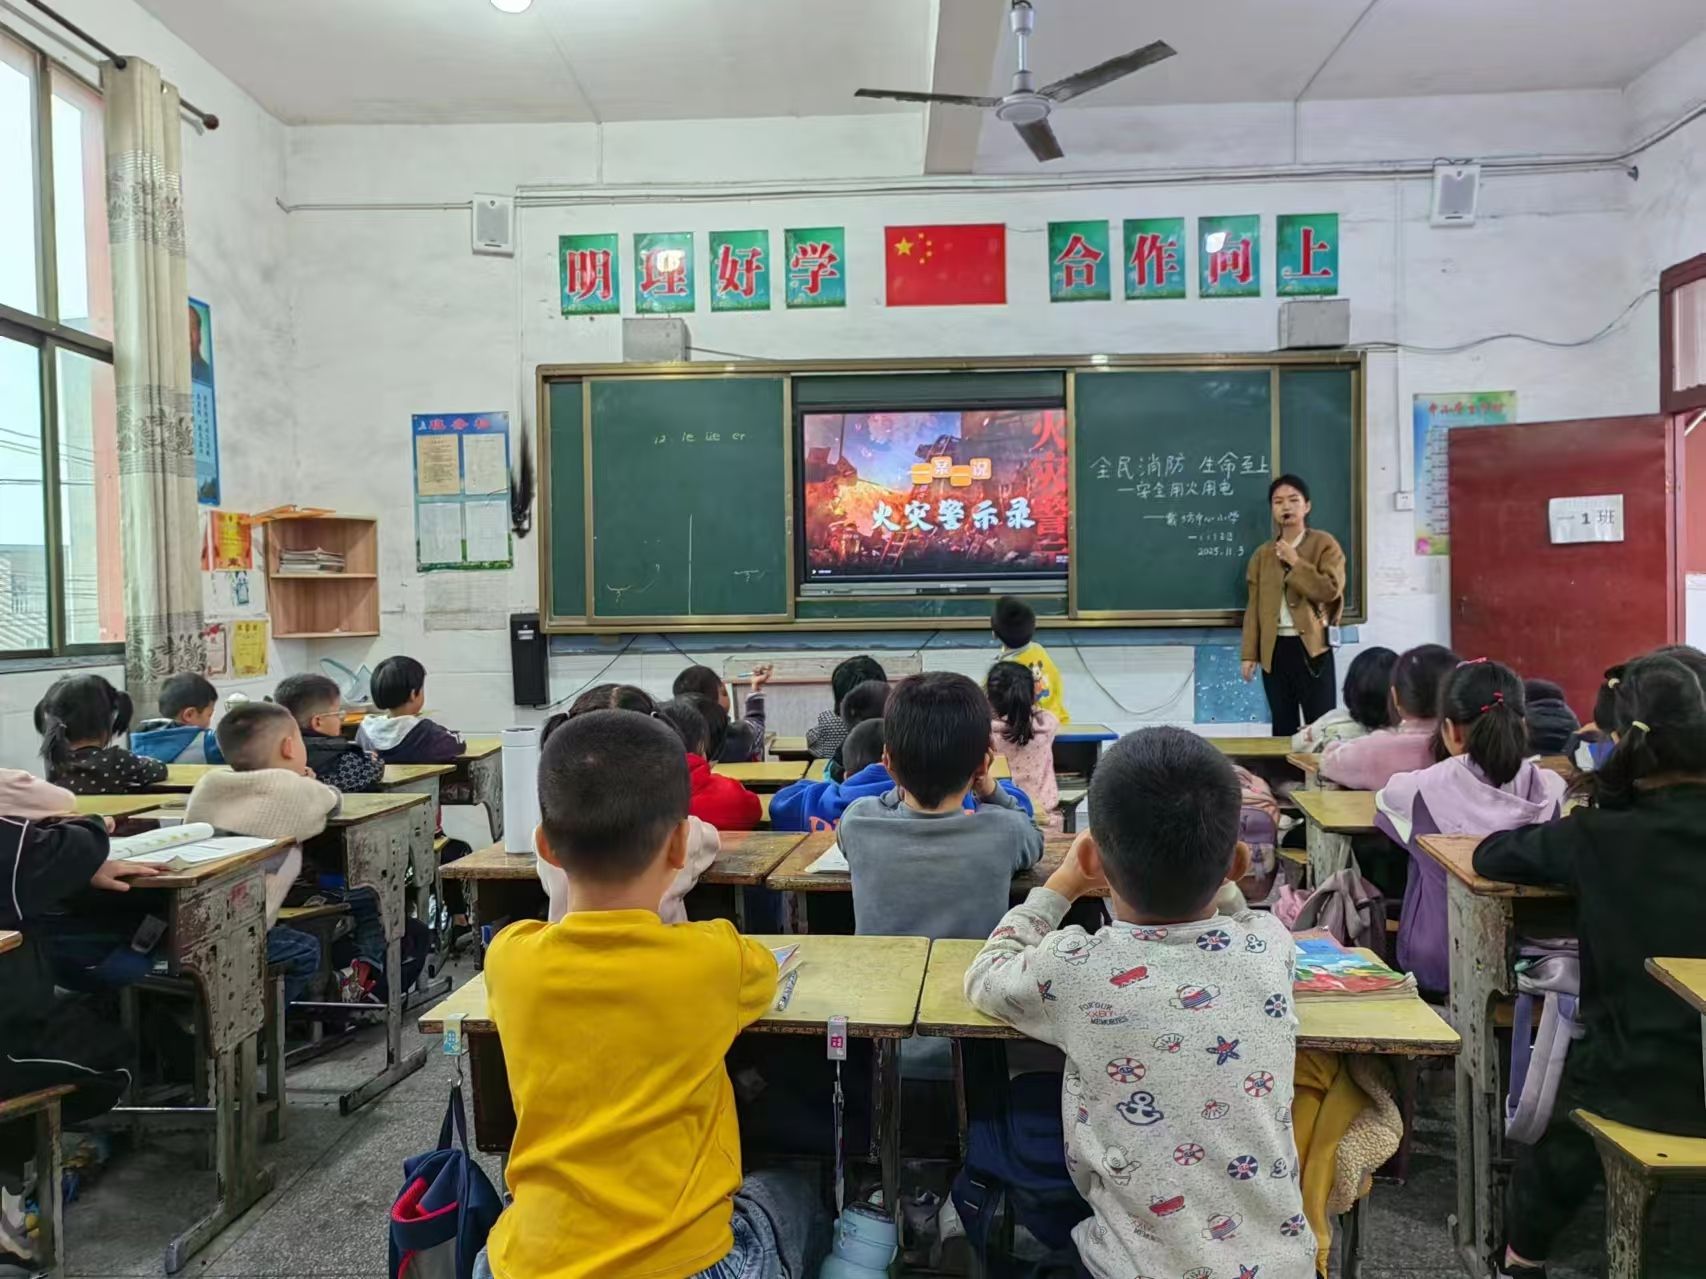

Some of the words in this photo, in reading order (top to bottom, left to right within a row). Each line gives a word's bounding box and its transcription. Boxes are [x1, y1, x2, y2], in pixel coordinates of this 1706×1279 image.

[566, 242, 839, 302] 明理好学
[1055, 227, 1333, 288] 合作向上
[1090, 453, 1186, 479] 全民消防
[1198, 451, 1270, 480] 生命至上
[871, 496, 1036, 533] 火灾警示录
